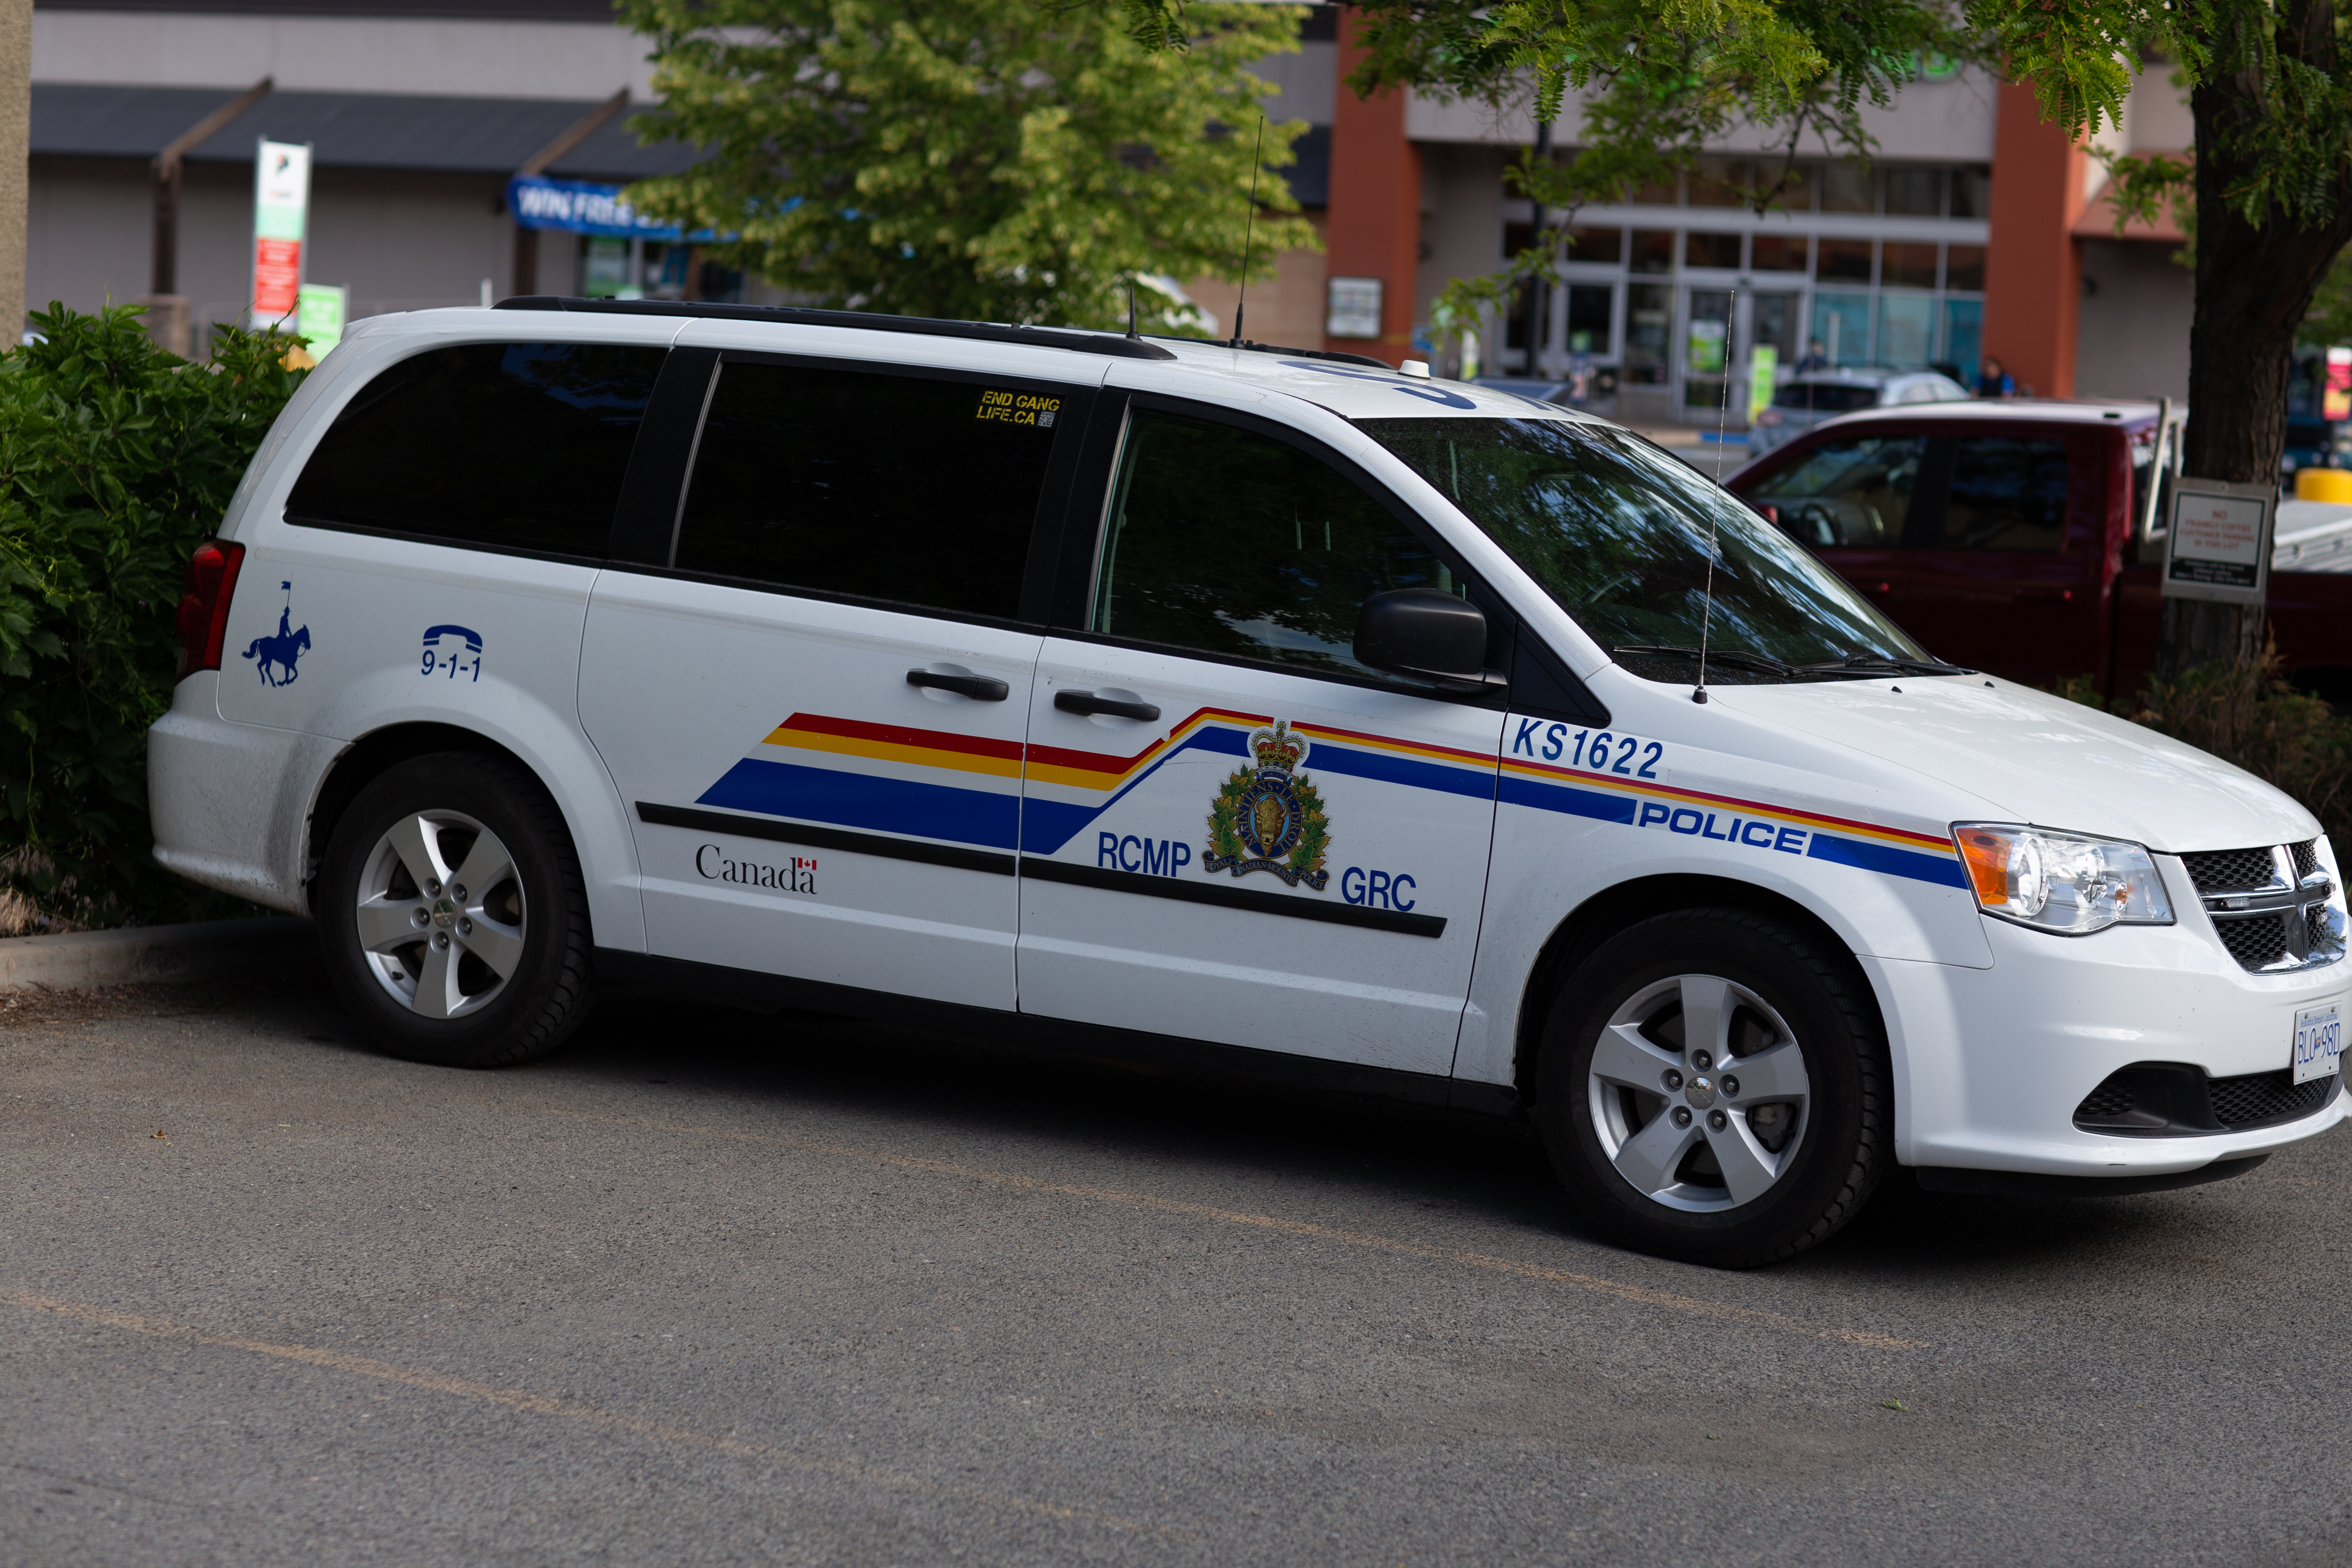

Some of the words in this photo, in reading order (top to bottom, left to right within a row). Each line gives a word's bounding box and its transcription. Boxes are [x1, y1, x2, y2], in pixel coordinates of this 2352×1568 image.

[976, 406, 1035, 425] LIFE.CA
[982, 391, 1013, 406] END
[1016, 395, 1060, 411] GANG
[2212, 510, 2228, 521] NO
[421, 649, 481, 682] 9-1-1
[1513, 717, 1663, 779] KS1622
[1262, 772, 1286, 780] CANADA
[1280, 787, 1295, 804] LE
[1239, 781, 1273, 847] MAINTIENS
[1638, 802, 1807, 855] POLICE
[1280, 811, 1300, 854] DROIT
[696, 844, 817, 894] Canada
[1098, 831, 1191, 877] RCMP
[1206, 859, 1228, 870] ROYAL
[1231, 861, 1266, 875] CANADIAN
[1268, 863, 1298, 885] MOUNTED
[1302, 870, 1325, 889] POLICE
[1341, 866, 1416, 912] GRC
[2300, 1016, 2314, 1028] Beautiful
[2314, 1014, 2323, 1024] British
[2324, 1012, 2337, 1022] Columbia
